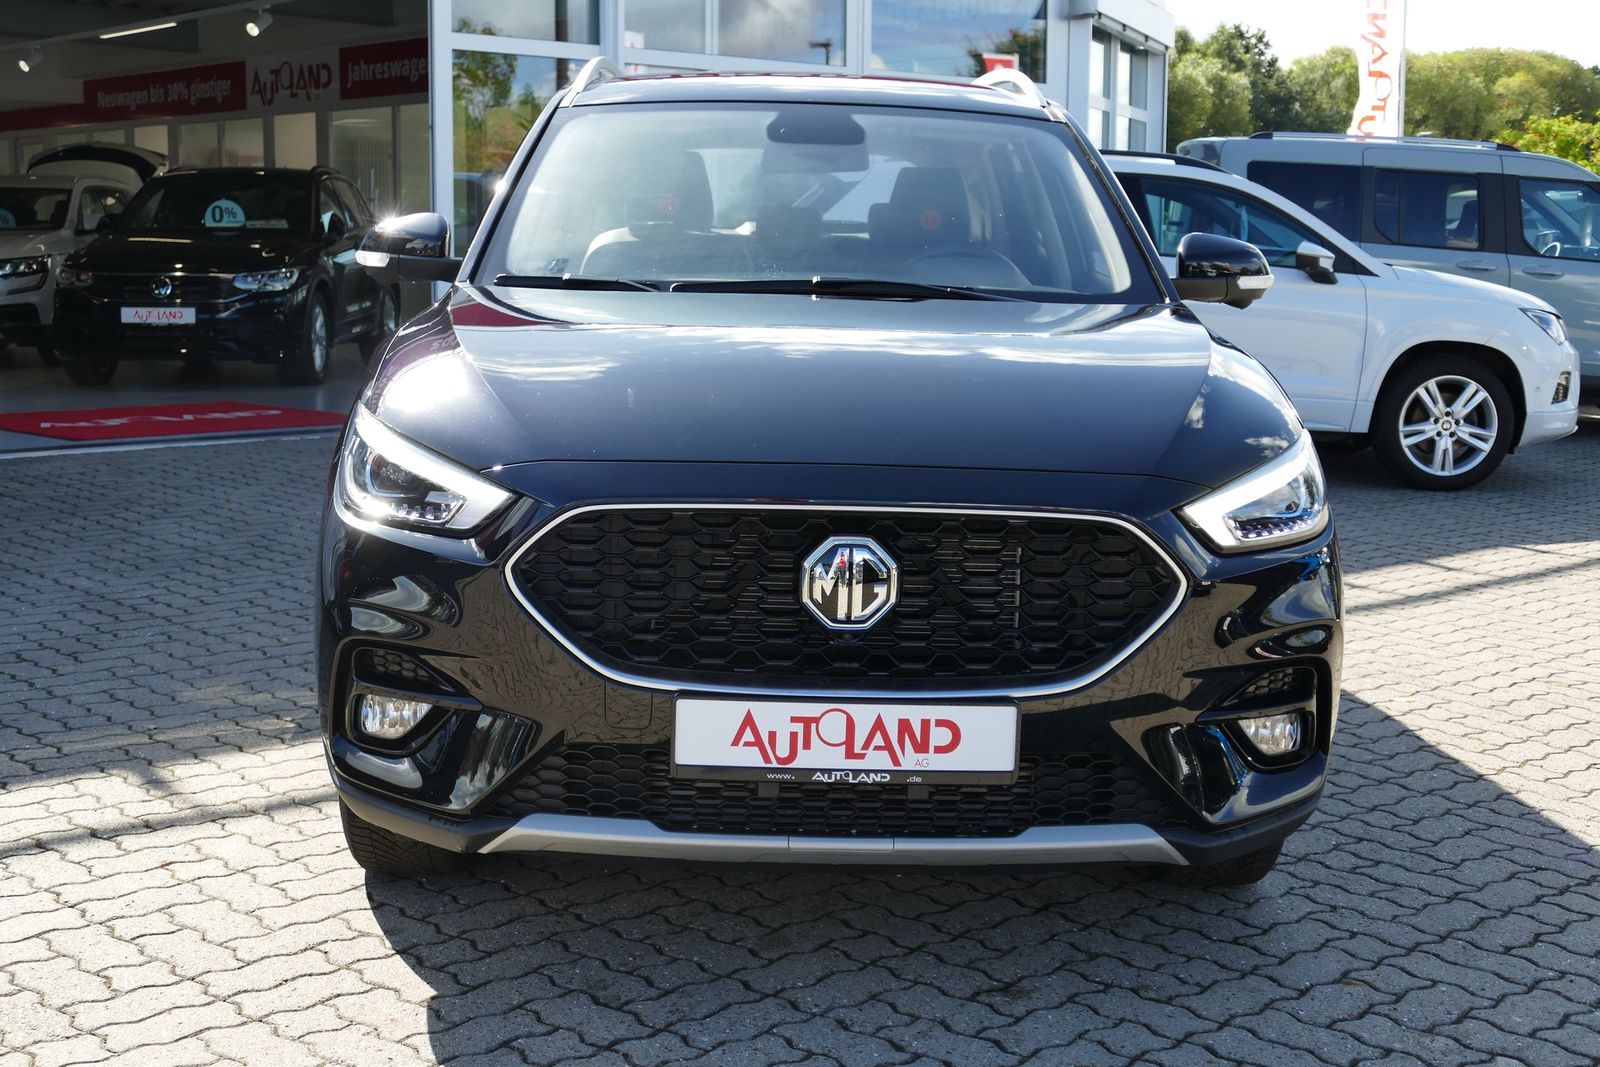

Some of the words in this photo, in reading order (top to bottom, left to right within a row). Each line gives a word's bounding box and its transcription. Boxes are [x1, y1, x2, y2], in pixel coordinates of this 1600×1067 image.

[97, 89, 149, 111] Neuwagen
[149, 83, 165, 103] bis
[190, 75, 233, 105] günstiger
[251, 61, 332, 106] AUTOLAND
[211, 204, 238, 224] 0%
[812, 547, 888, 621] MG
[730, 707, 962, 767] AUTOLAND
[812, 770, 891, 783] AUTOLAND
[914, 757, 930, 768] AG
